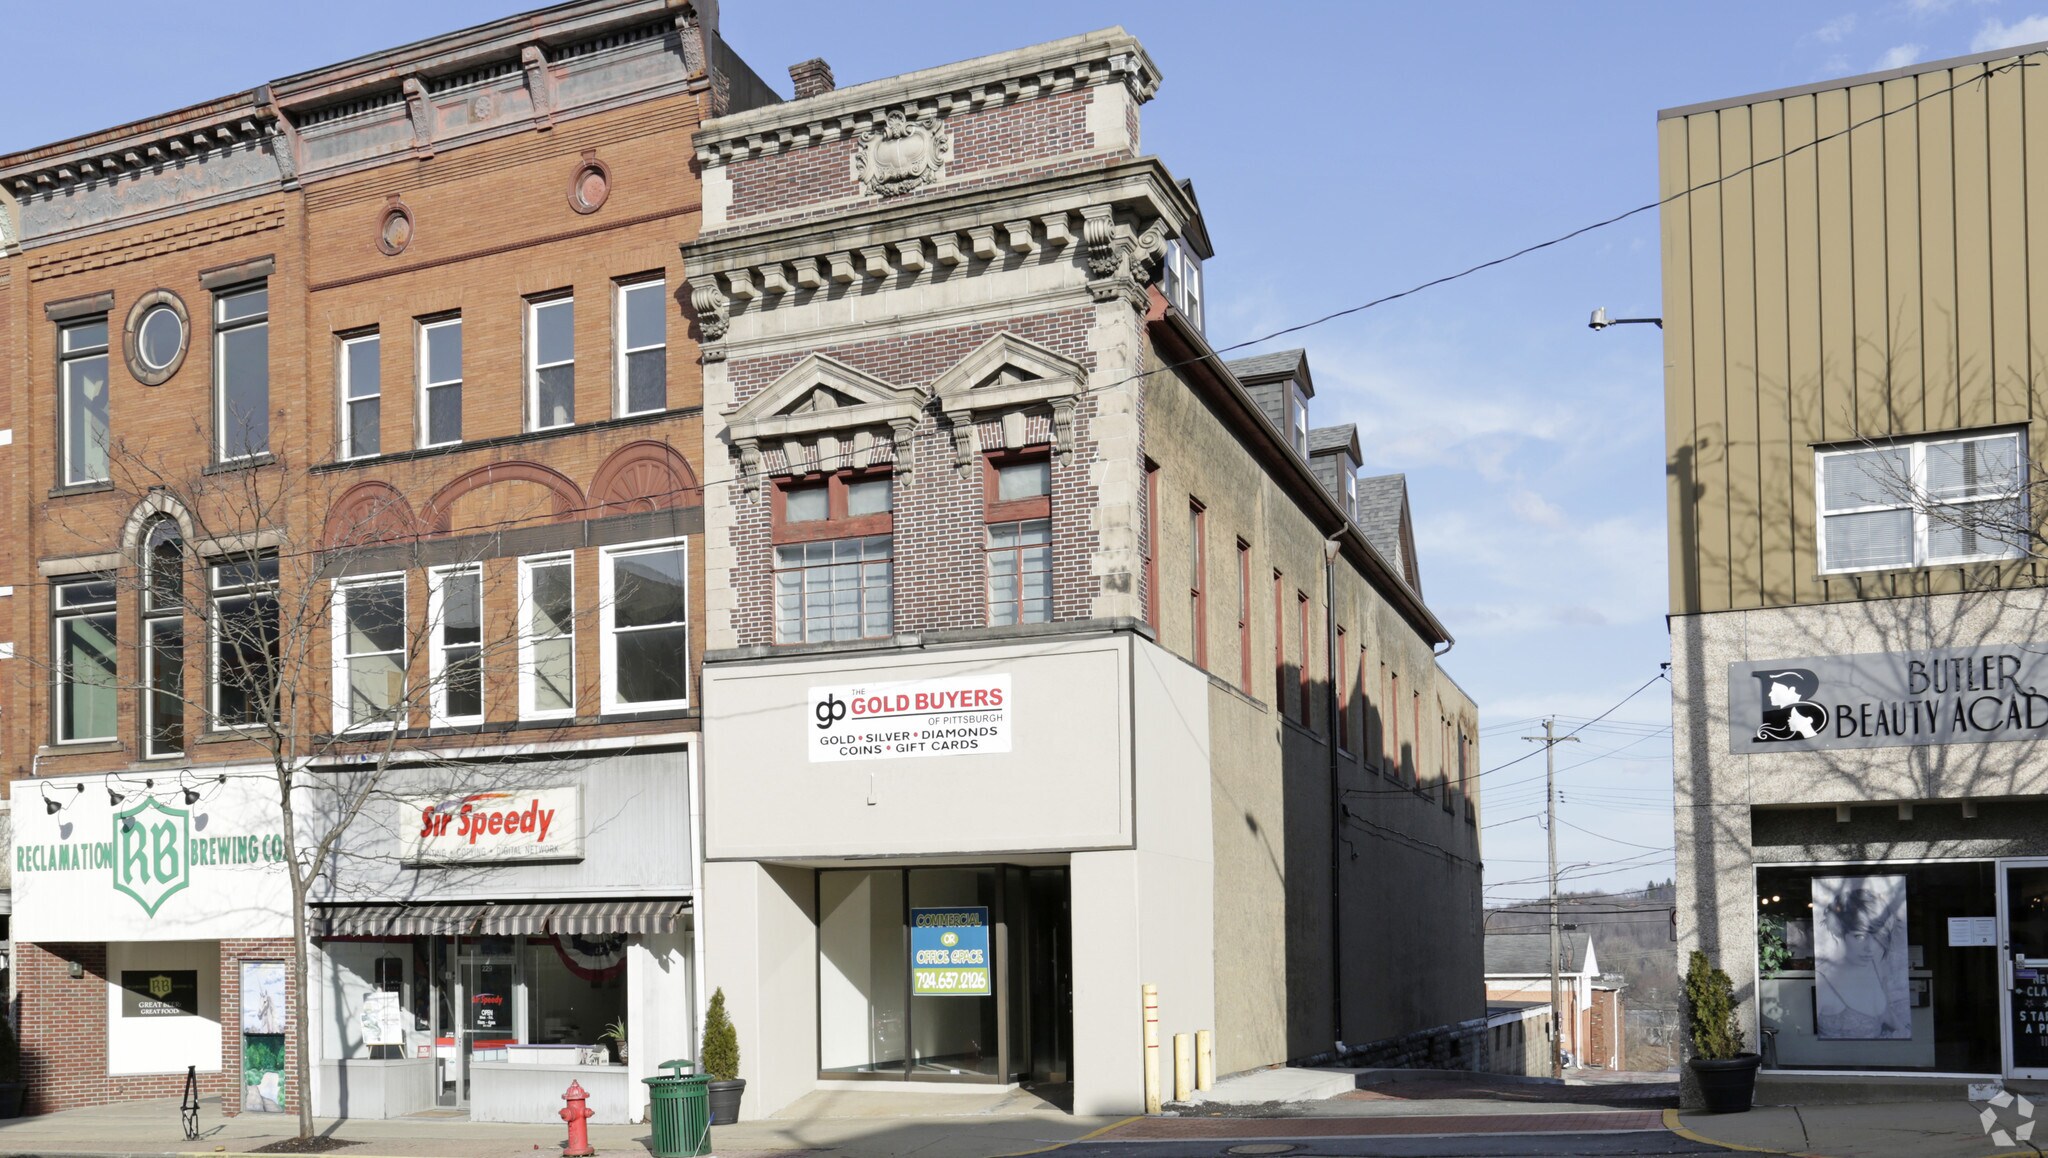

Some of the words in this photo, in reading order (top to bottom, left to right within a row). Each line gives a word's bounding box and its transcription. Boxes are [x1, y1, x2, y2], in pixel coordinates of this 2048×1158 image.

[1908, 654, 2037, 696] BUTLER
[851, 694, 911, 715] GOLD
[915, 688, 1004, 710] BUYERS
[928, 717, 941, 726] OF
[943, 714, 1003, 725] PITTSBURGH
[1836, 700, 1940, 739] BEAUTY
[820, 735, 856, 746] GOLD
[865, 732, 911, 743] SILVER
[921, 727, 998, 740] DIAMONDS
[839, 745, 882, 757] COINS
[896, 743, 925, 753] GIFT
[931, 740, 979, 752] CARDS
[420, 805, 453, 838] Sir
[457, 799, 555, 844] Speedy
[16, 842, 113, 872] RECLAMATION
[120, 820, 180, 886] RB
[190, 835, 259, 866] BREWING
[457, 847, 486, 856] COPYING
[497, 845, 522, 855] DIGITAL
[525, 844, 559, 854] NETWORK
[916, 913, 982, 928] COMMERCIAL
[943, 934, 956, 944] OR
[916, 950, 950, 964] OFFICE
[950, 949, 984, 964] SPACE
[151, 979, 170, 993] RB
[916, 971, 986, 989] 724.637.2126
